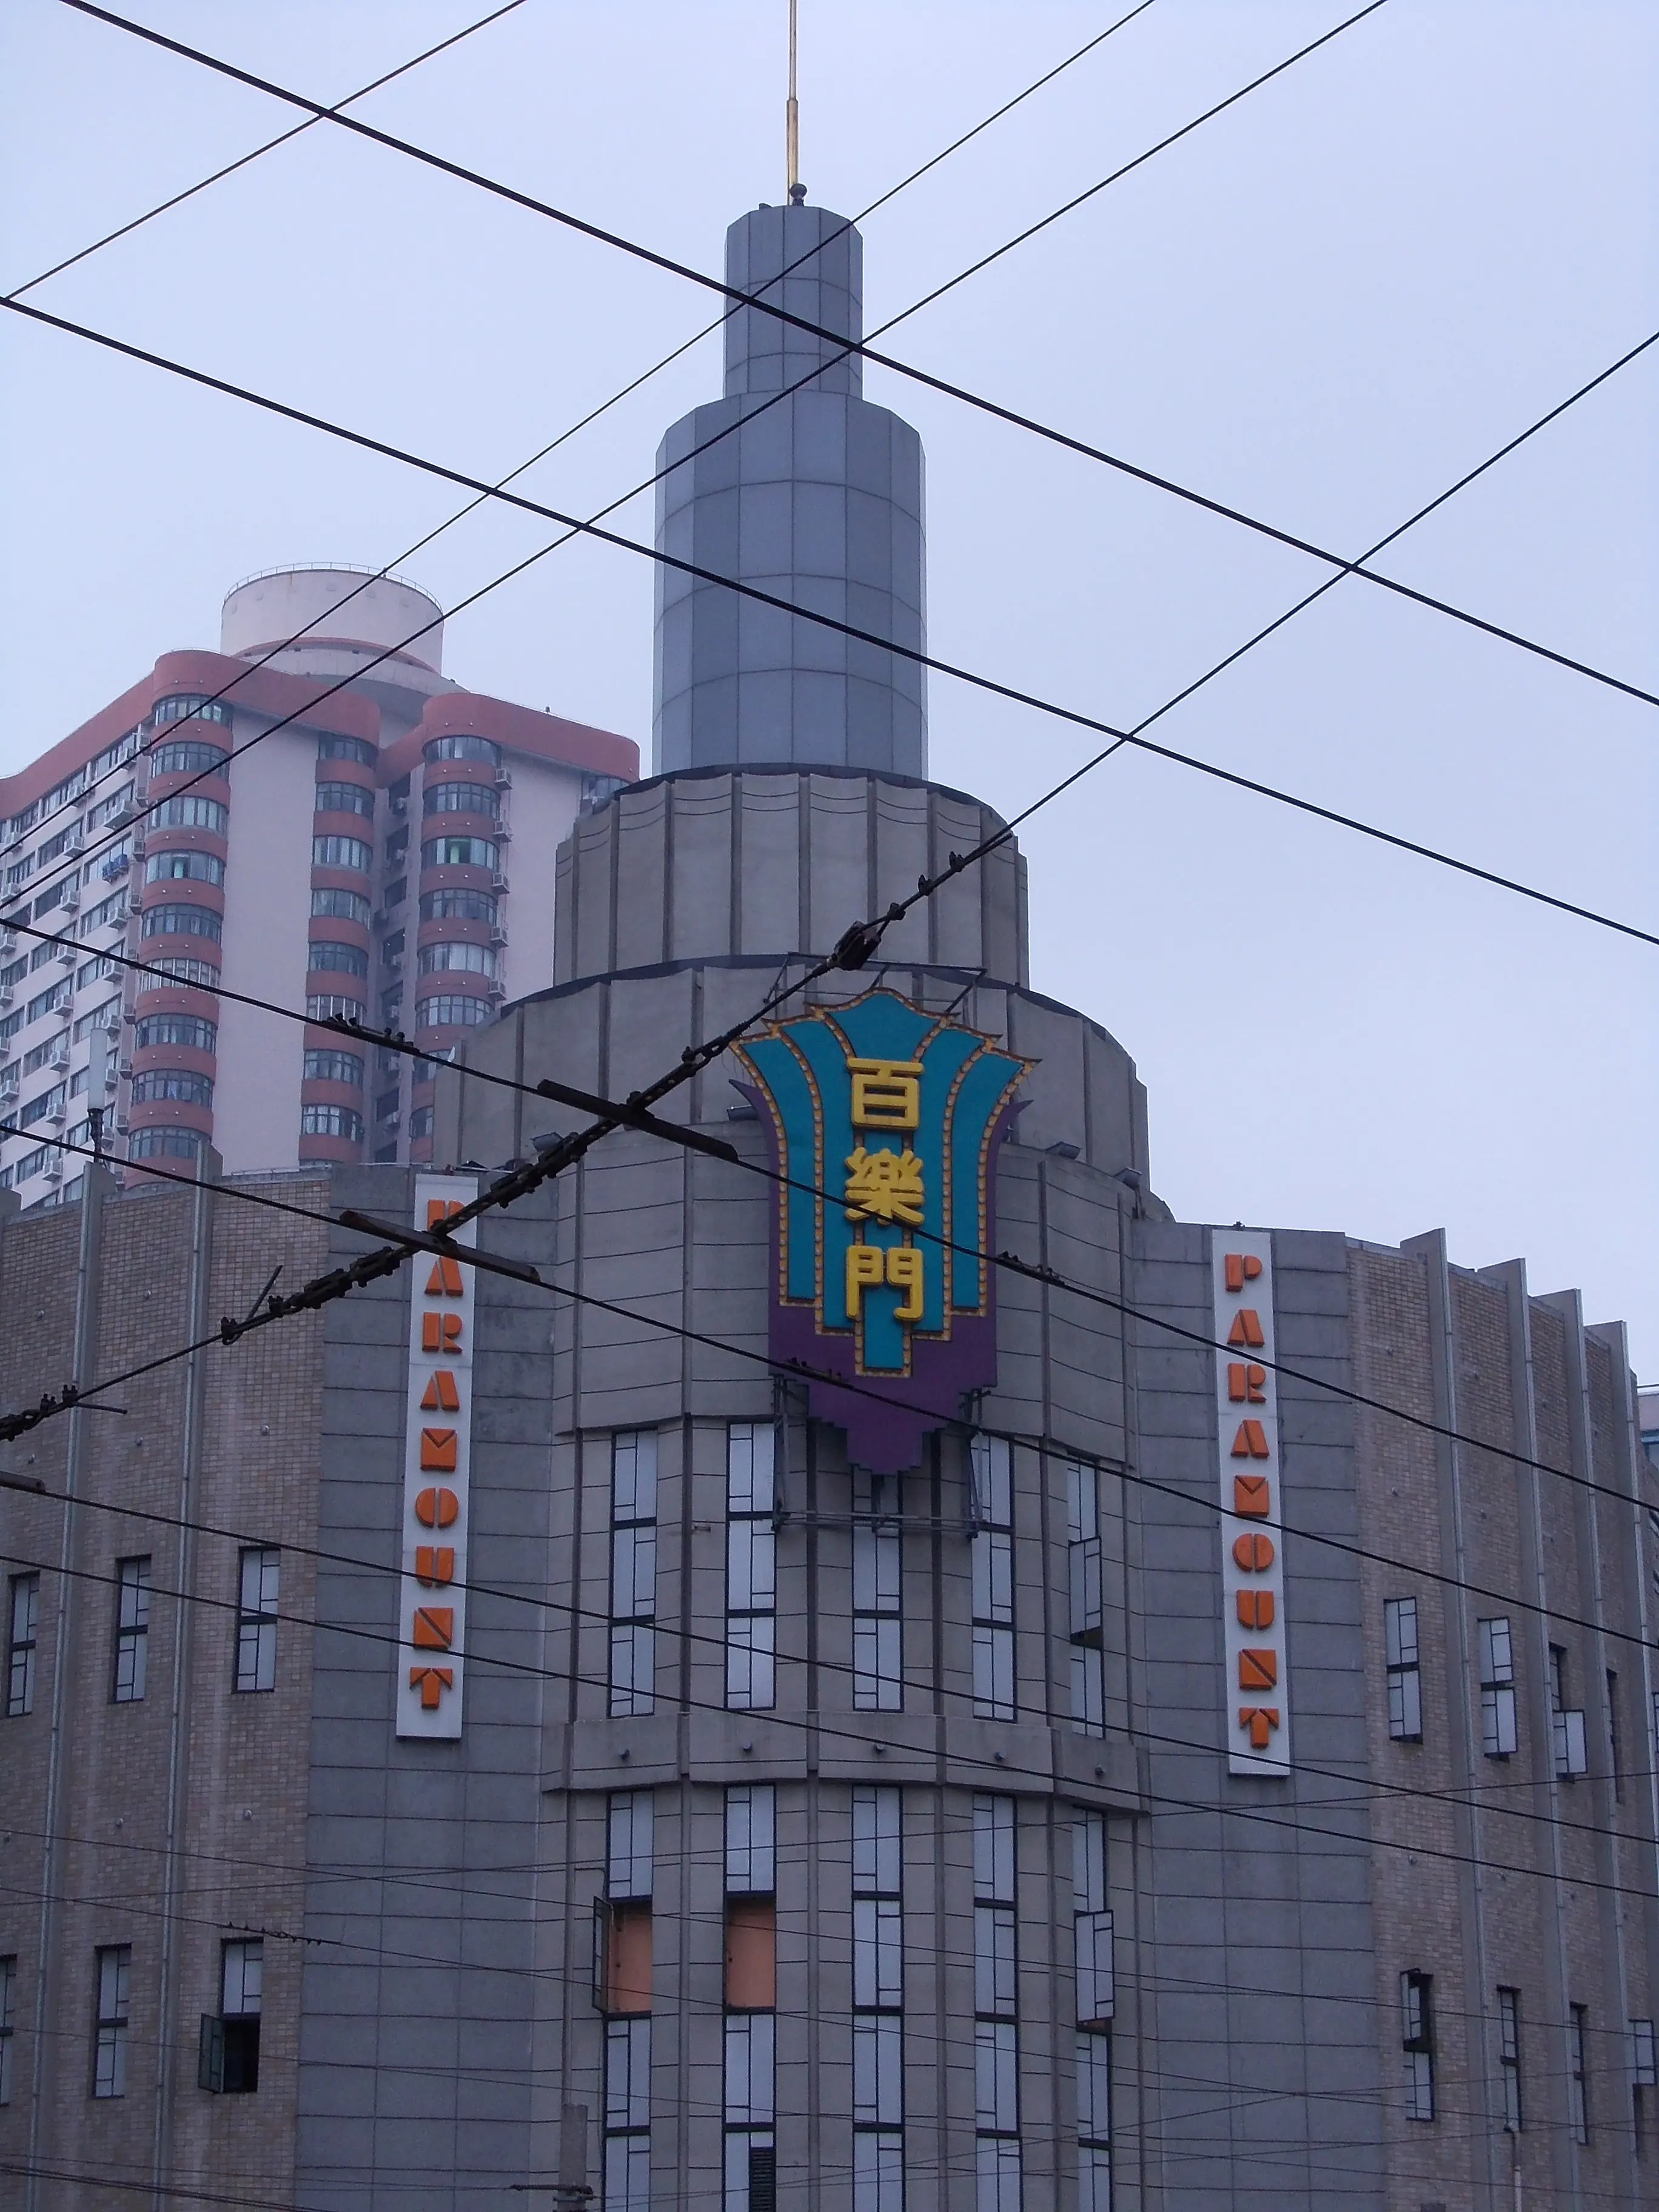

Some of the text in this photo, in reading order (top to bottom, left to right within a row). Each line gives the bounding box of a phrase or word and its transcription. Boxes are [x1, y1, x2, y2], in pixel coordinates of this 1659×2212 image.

[845, 1057, 924, 1320] 百樂門
[1224, 1254, 1279, 1749] PARAMOUNT
